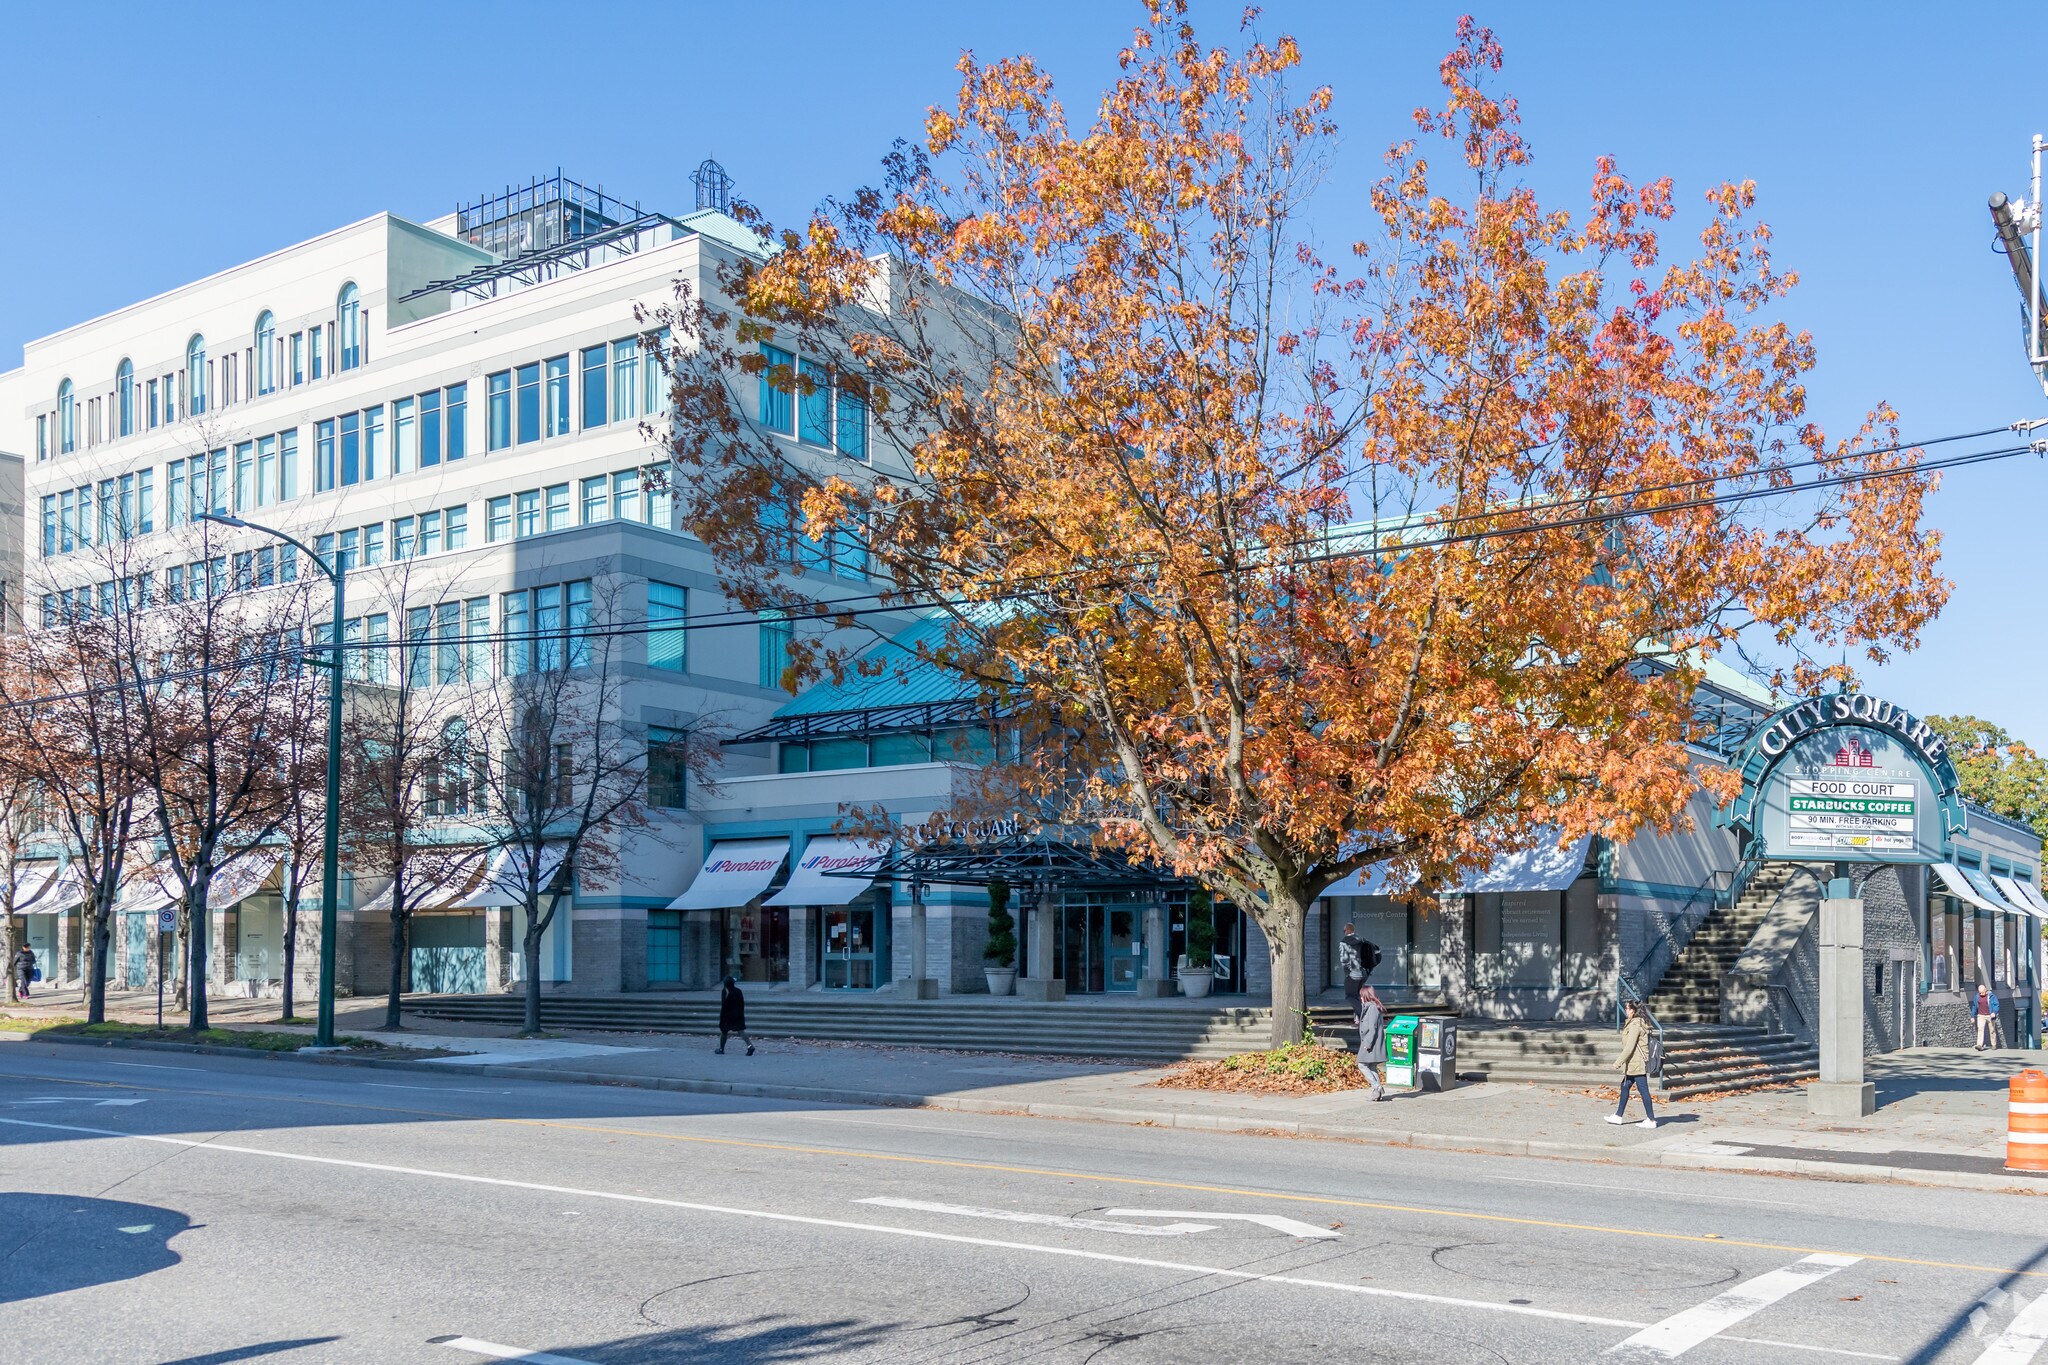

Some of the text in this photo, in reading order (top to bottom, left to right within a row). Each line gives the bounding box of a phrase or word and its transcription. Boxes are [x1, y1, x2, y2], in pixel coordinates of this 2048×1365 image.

[1760, 694, 1947, 763] CITY SQUARE
[1795, 766, 1911, 778] SHOPPING CENTRE
[1812, 782, 1894, 795] FOOD COURT
[1793, 799, 1912, 813] STARBUCKS COFFEE
[1808, 816, 1897, 827] 90 MIN. FREE PARKING
[1836, 836, 1871, 846] SUBWAY
[718, 859, 779, 873] Purolator
[1352, 911, 1384, 920] Discovery
